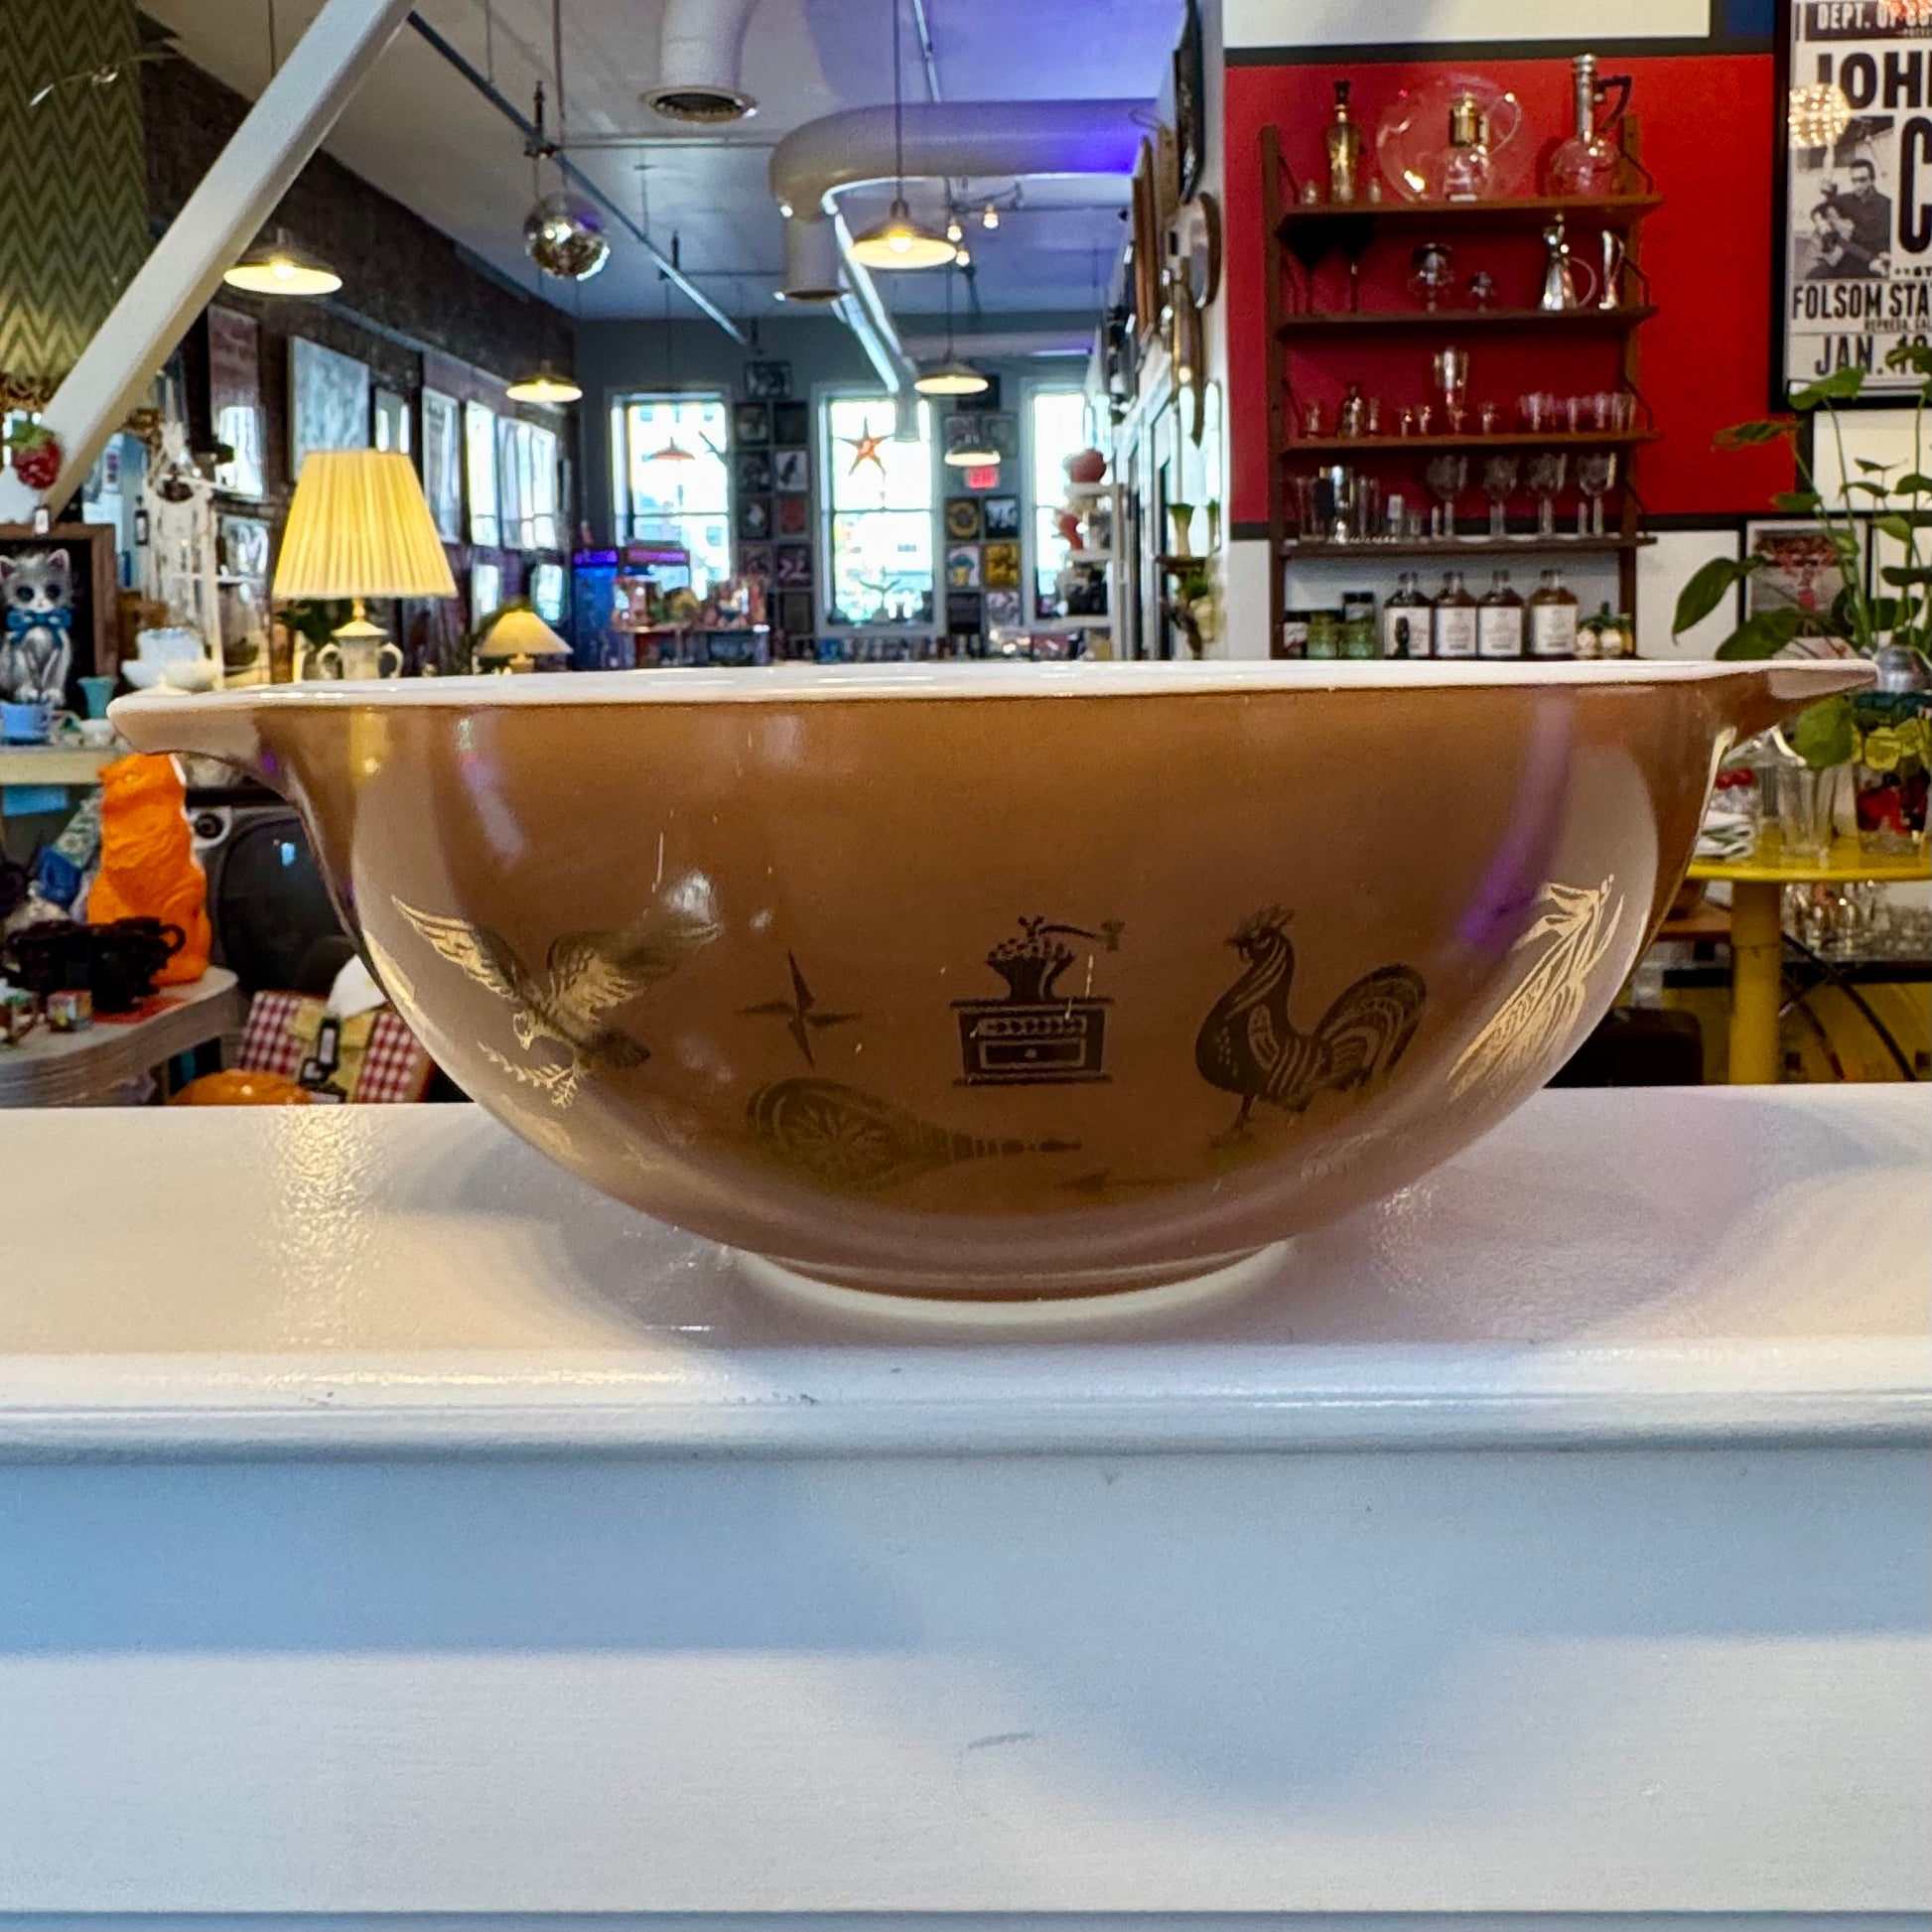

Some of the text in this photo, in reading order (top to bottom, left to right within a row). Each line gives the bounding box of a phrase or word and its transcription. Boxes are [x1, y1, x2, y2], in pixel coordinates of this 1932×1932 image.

[1816, 3, 1871, 31] DEPT.
[1792, 282, 1932, 320] FOLSOM STA
[1814, 334, 1883, 376] JAN.
